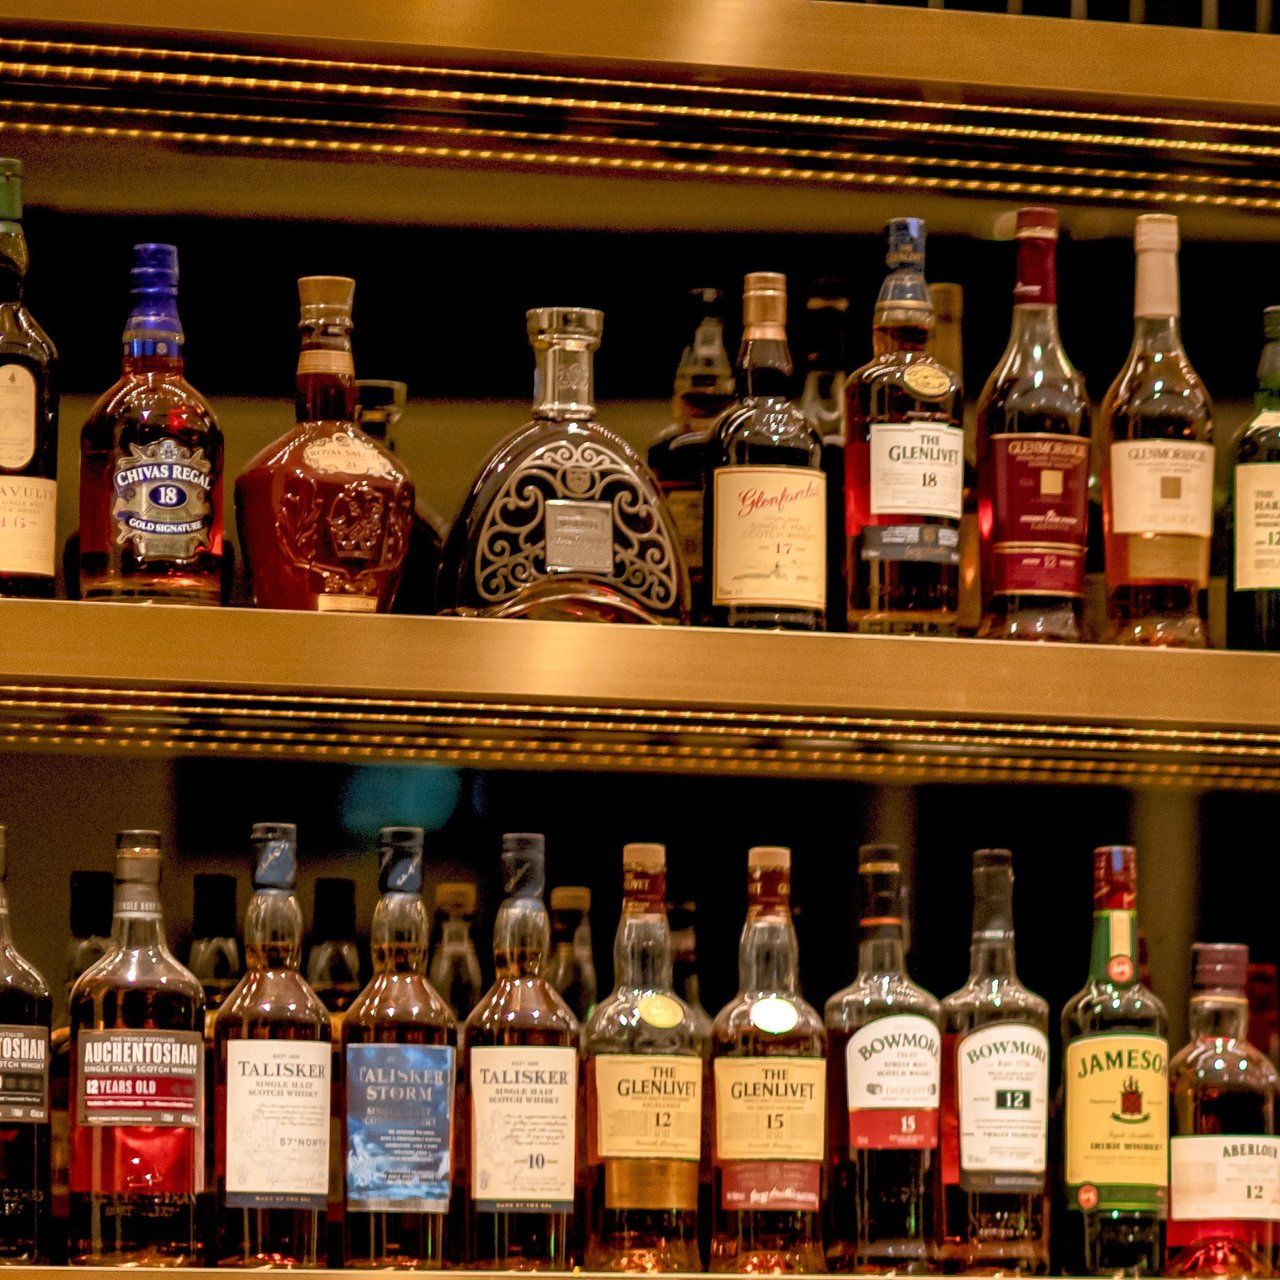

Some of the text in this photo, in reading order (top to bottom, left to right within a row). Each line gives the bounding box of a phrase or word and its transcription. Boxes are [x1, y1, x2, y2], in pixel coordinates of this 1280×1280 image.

[920, 434, 940, 446] THE
[888, 444, 960, 465] GLENLIVET
[117, 463, 211, 491] CHIVAS REGAL
[922, 472, 938, 488] 18
[157, 486, 178, 505] 18
[128, 517, 202, 533] GOLD SIGNATURE
[84, 1042, 198, 1066] AUCHENTOSHAN
[858, 1033, 939, 1062] BOWMORE
[84, 1065, 197, 1075] SINGLE MALT SCOTCH WHISKY
[238, 1060, 327, 1079] TALISKER
[359, 1066, 444, 1086] TALISKER
[480, 1067, 569, 1086] TALISKER
[651, 1066, 676, 1079] THE
[762, 1068, 788, 1081] THE
[86, 1079, 157, 1095] 12 YEARS OLD
[366, 1085, 433, 1102] STORM
[617, 1078, 697, 1098] GLENLIVET
[731, 1081, 814, 1100] GLENLIVET
[1005, 1091, 1025, 1107] 12
[655, 1111, 672, 1128] 12
[766, 1113, 784, 1130] 15
[901, 1114, 916, 1133] 15
[528, 1152, 546, 1170] 10
[1246, 1184, 1264, 1200] 12
